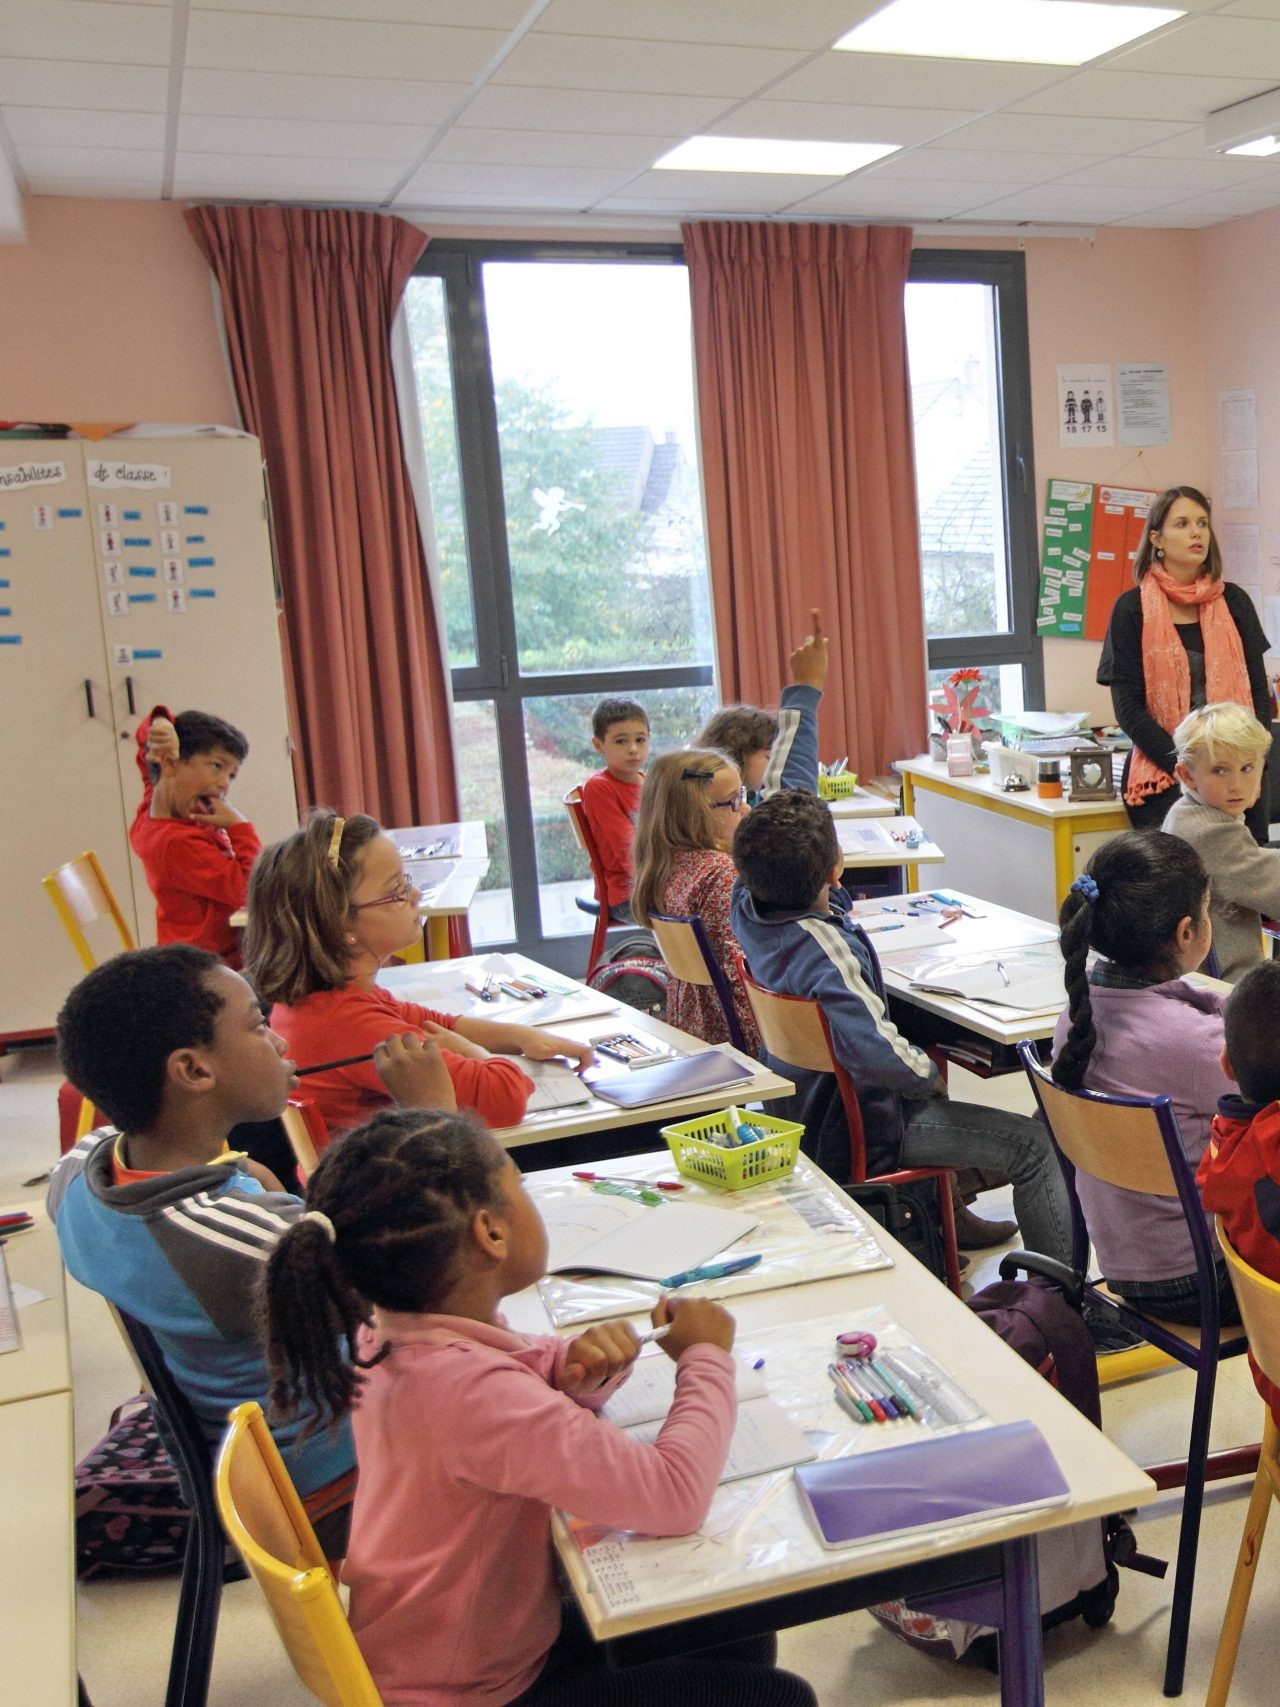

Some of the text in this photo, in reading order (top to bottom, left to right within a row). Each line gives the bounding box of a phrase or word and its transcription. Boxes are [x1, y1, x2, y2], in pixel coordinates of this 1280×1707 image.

[1081, 425, 1092, 433] 17
[1096, 425, 1107, 433] 15
[116, 465, 157, 481] classe
